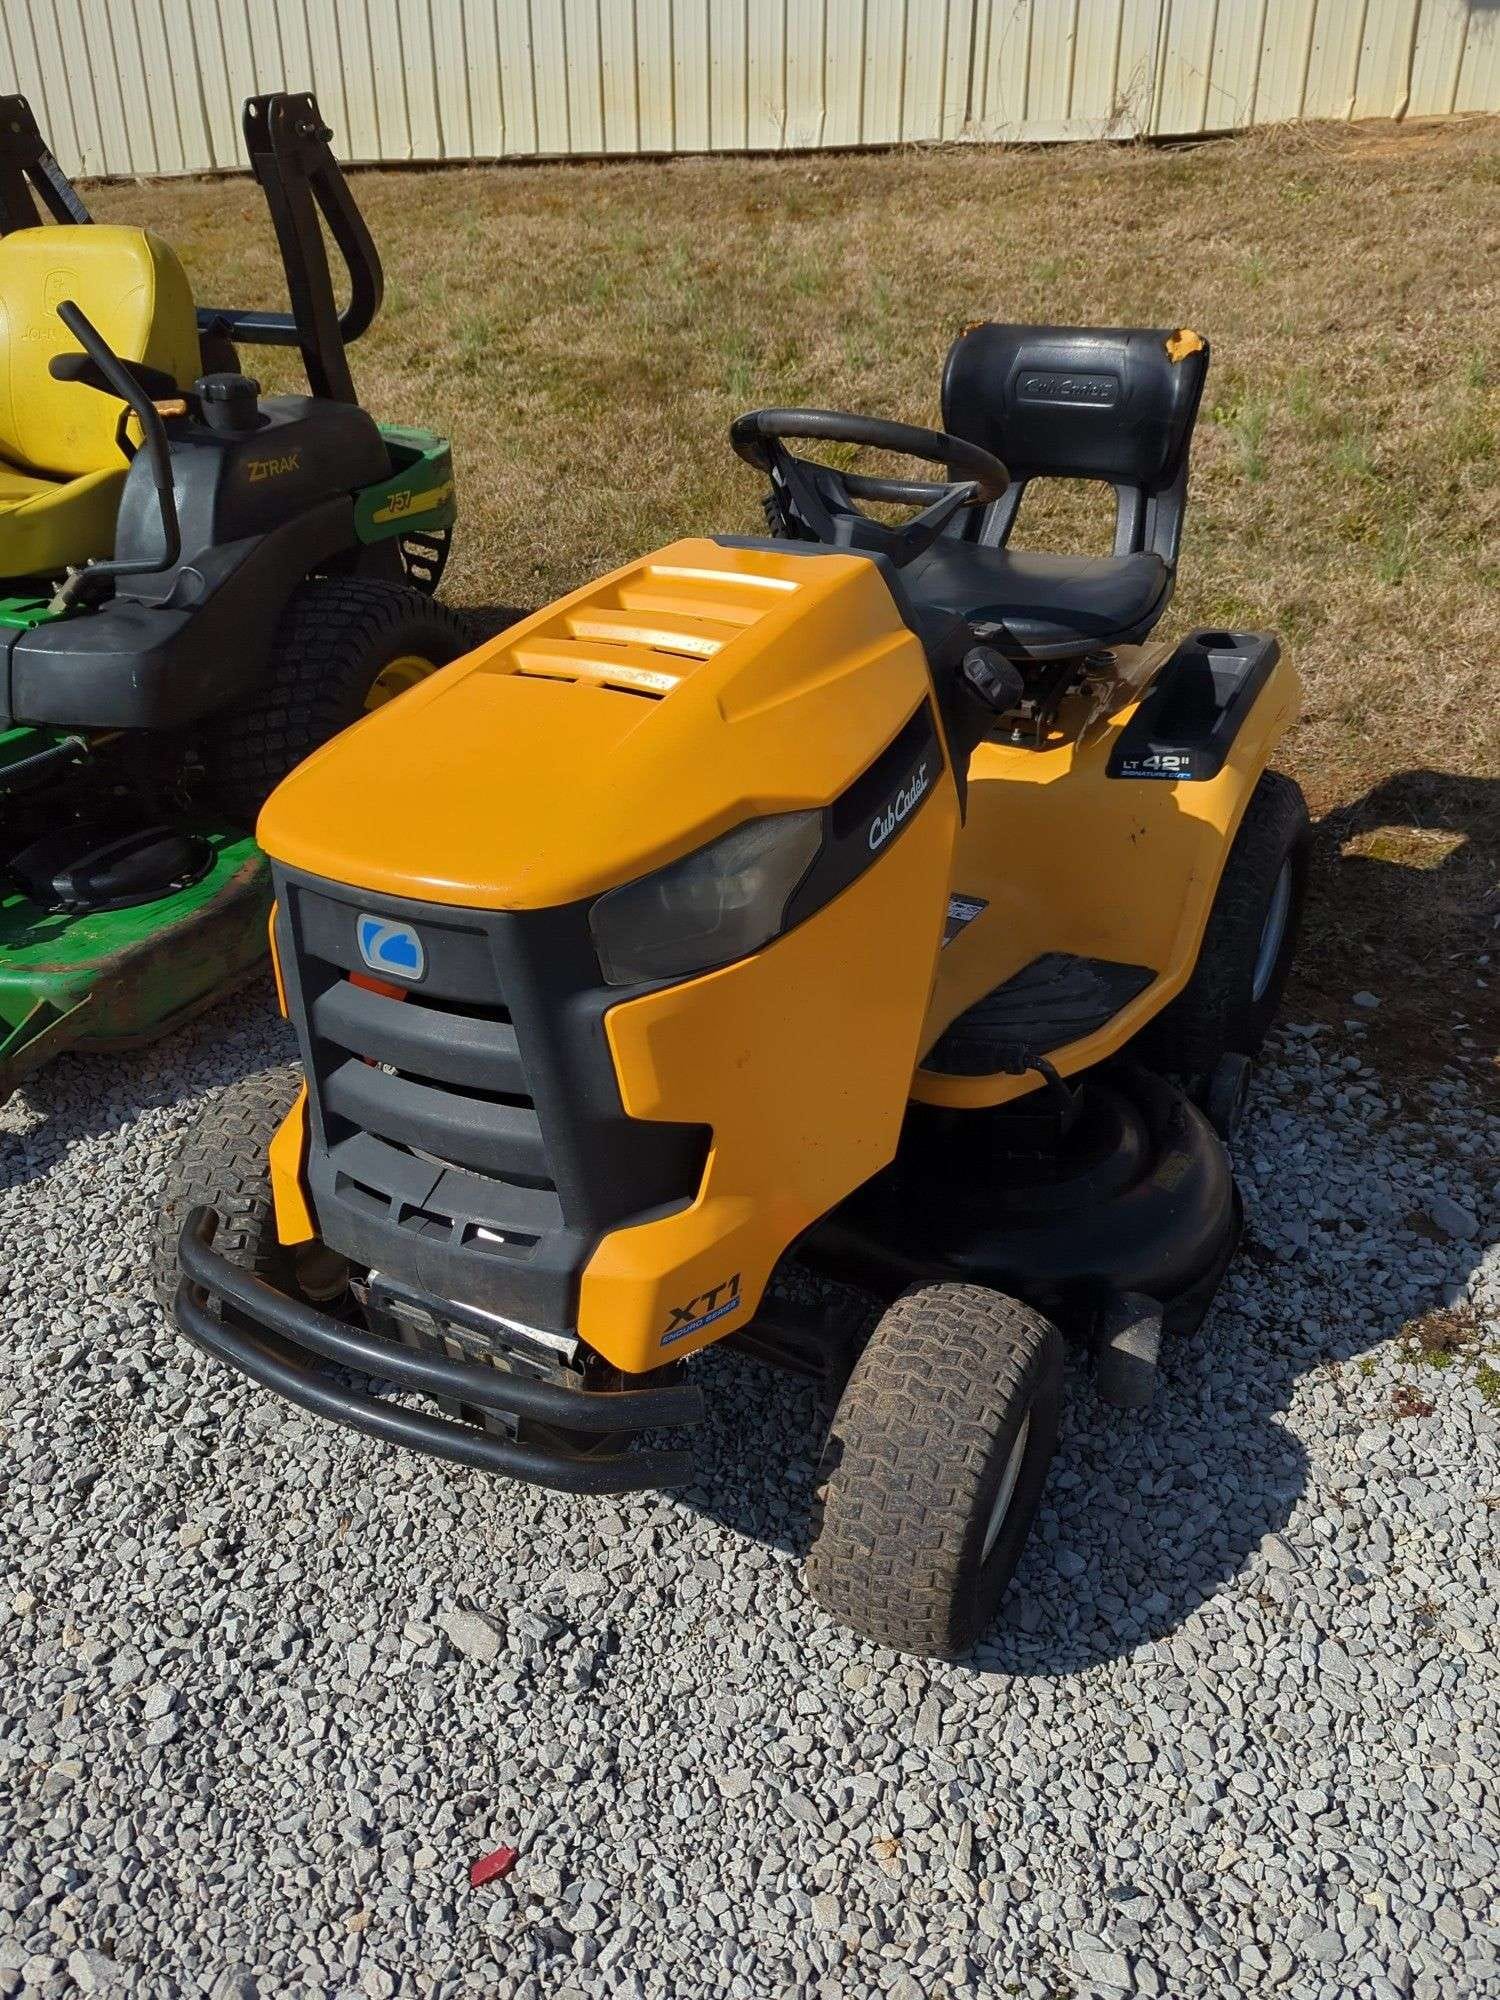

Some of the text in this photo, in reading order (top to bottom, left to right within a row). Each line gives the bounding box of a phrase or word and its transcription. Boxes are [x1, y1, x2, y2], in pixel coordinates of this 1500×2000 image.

[247, 454, 300, 482] ZTRAK
[386, 490, 411, 513] 757
[1121, 770, 1167, 778] SIGNATURE
[1122, 755, 1190, 771] LT 42"
[868, 762, 930, 850] Cub Cadet
[663, 1272, 741, 1333] XT1
[661, 1299, 739, 1344] ENDURO SERIES
